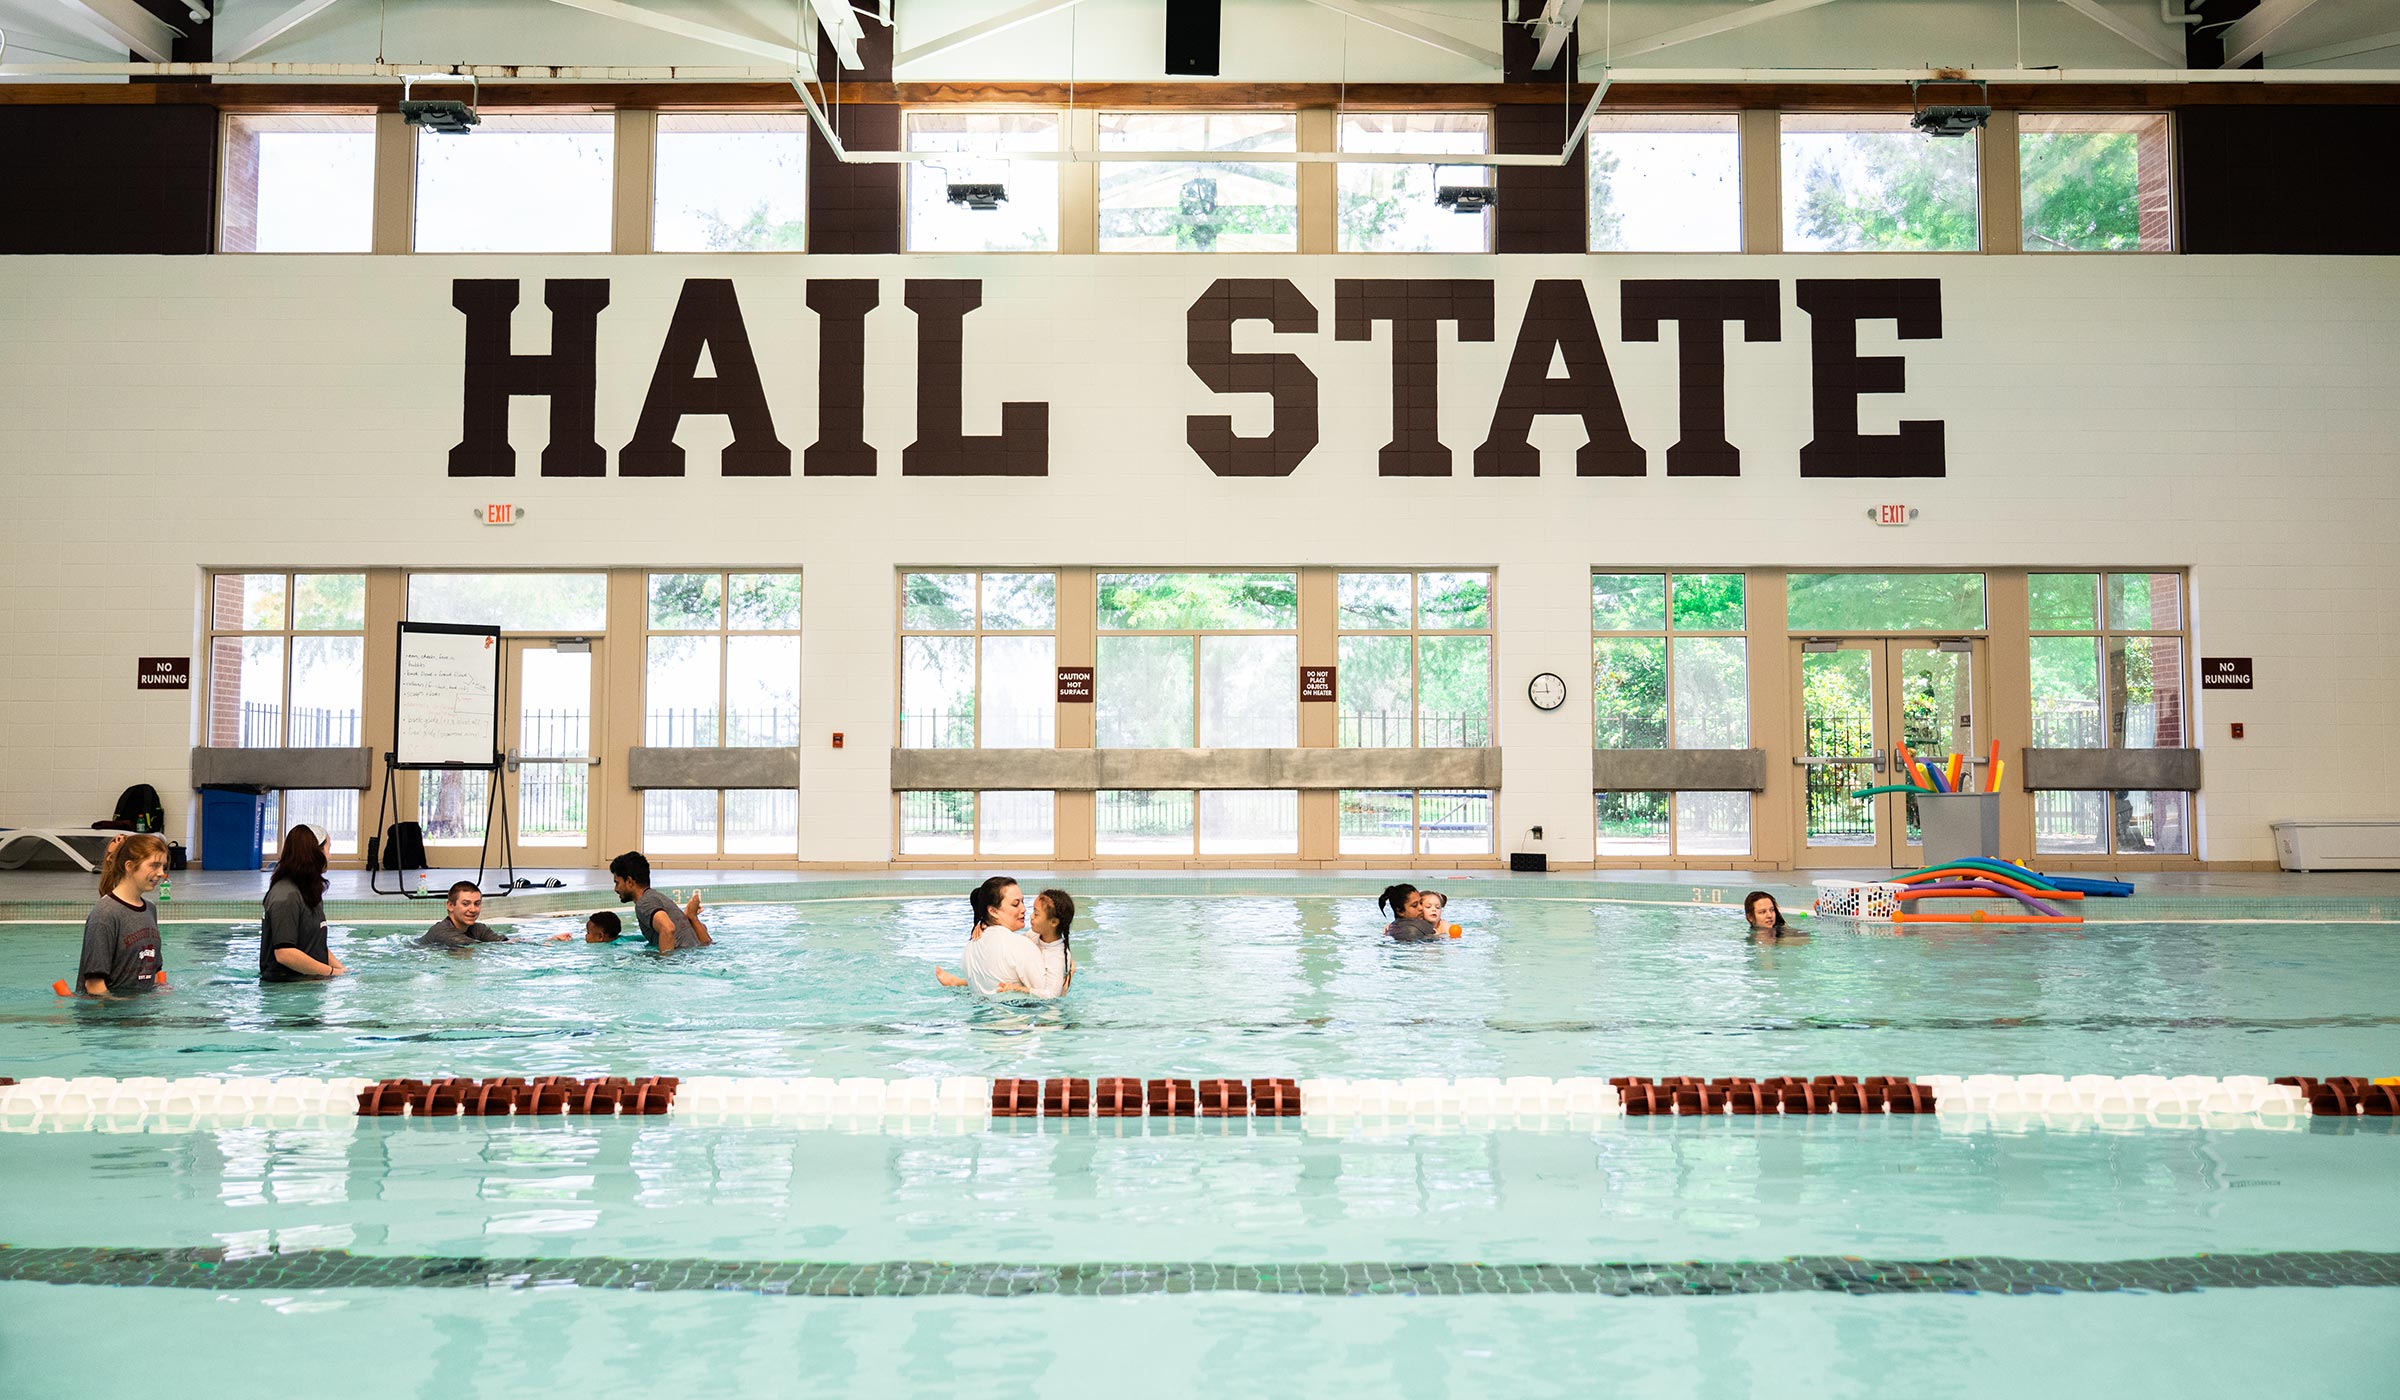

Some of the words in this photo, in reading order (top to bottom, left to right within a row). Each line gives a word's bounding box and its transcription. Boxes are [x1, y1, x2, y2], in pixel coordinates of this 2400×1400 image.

[447, 278, 1049, 478] HAIL
[1186, 278, 1947, 479] STATE
[488, 504, 512, 523] EXIT
[1881, 504, 1905, 523] EXIT
[156, 662, 172, 672] NO
[2219, 662, 2235, 672] NO
[141, 674, 187, 684] RUNNING
[2205, 674, 2251, 684] RUNNING
